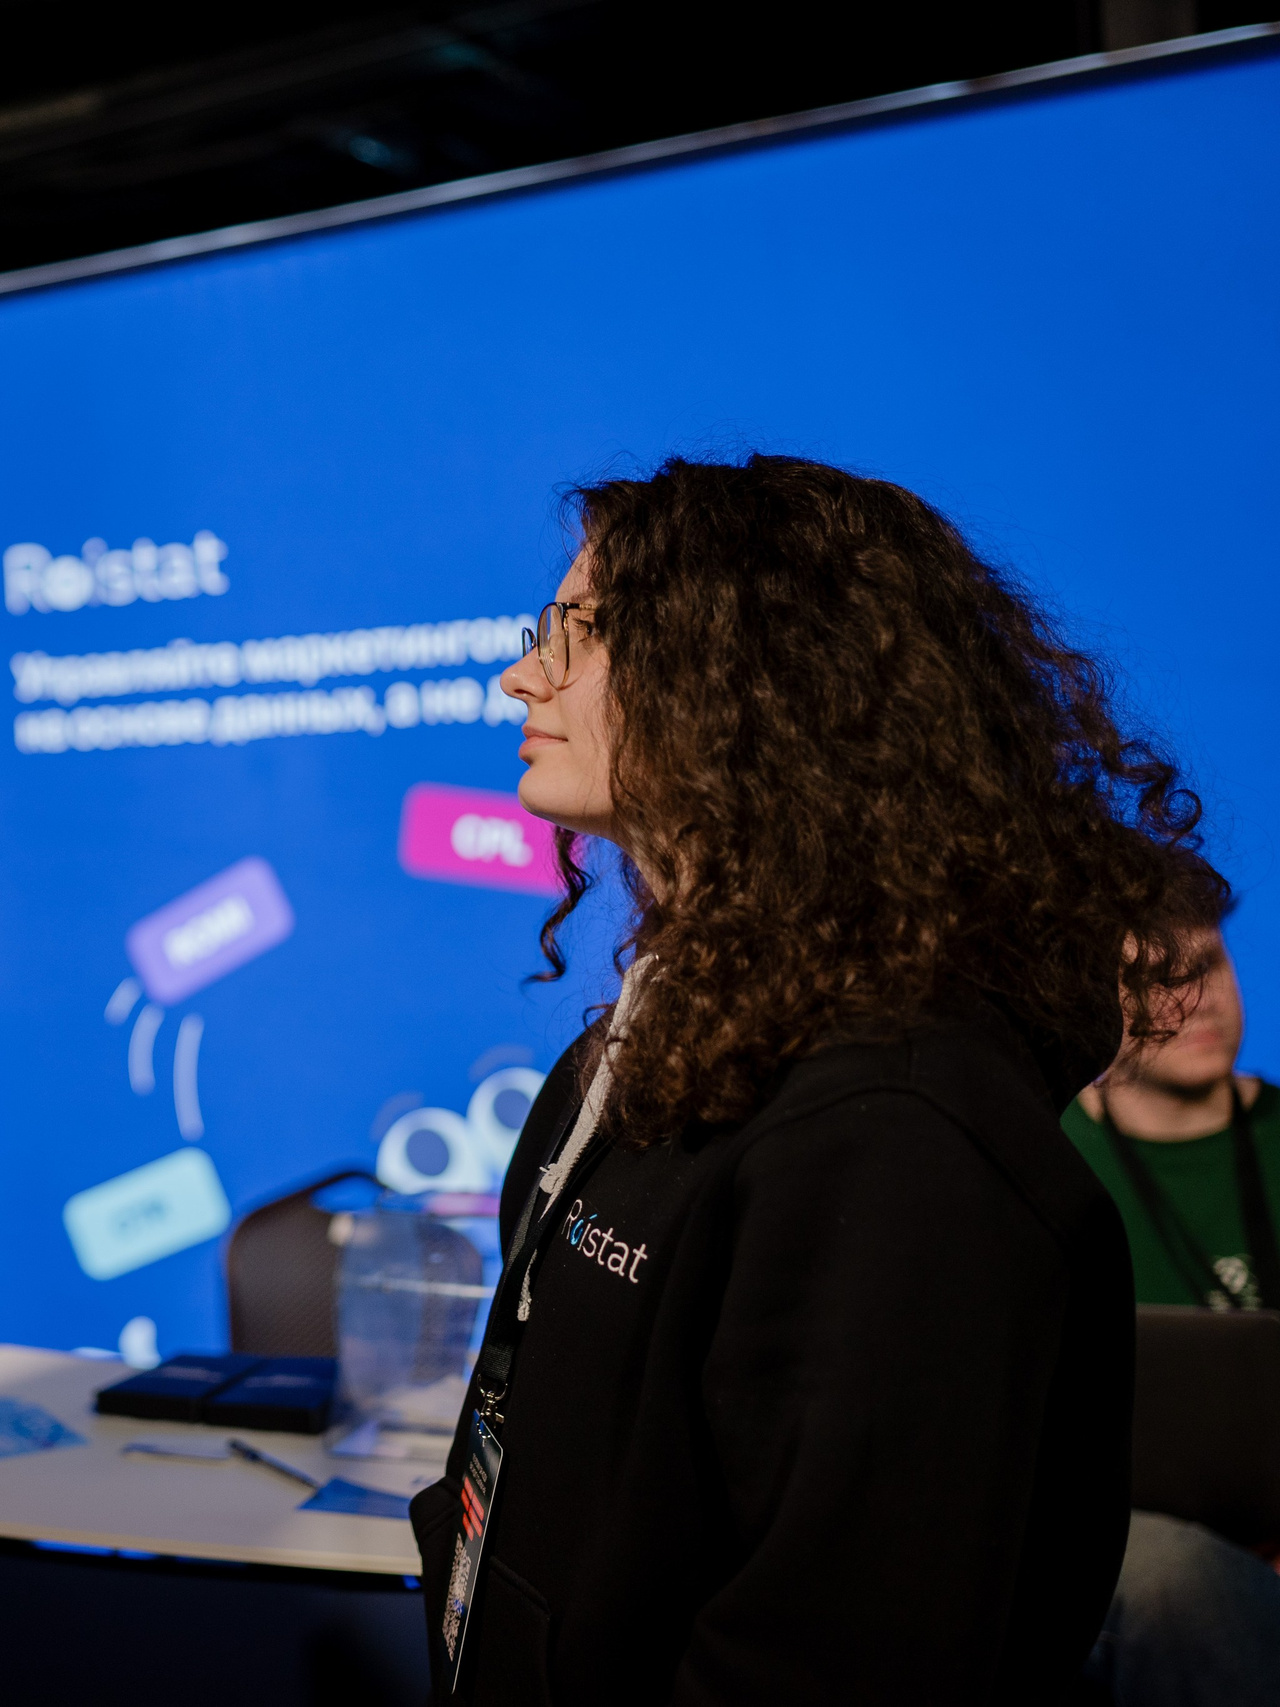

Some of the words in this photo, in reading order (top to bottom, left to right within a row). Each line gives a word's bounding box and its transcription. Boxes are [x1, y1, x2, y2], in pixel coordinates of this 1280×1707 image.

[5, 531, 227, 613] Roistat
[451, 814, 533, 867] CPL
[561, 1199, 648, 1283] Roistat
